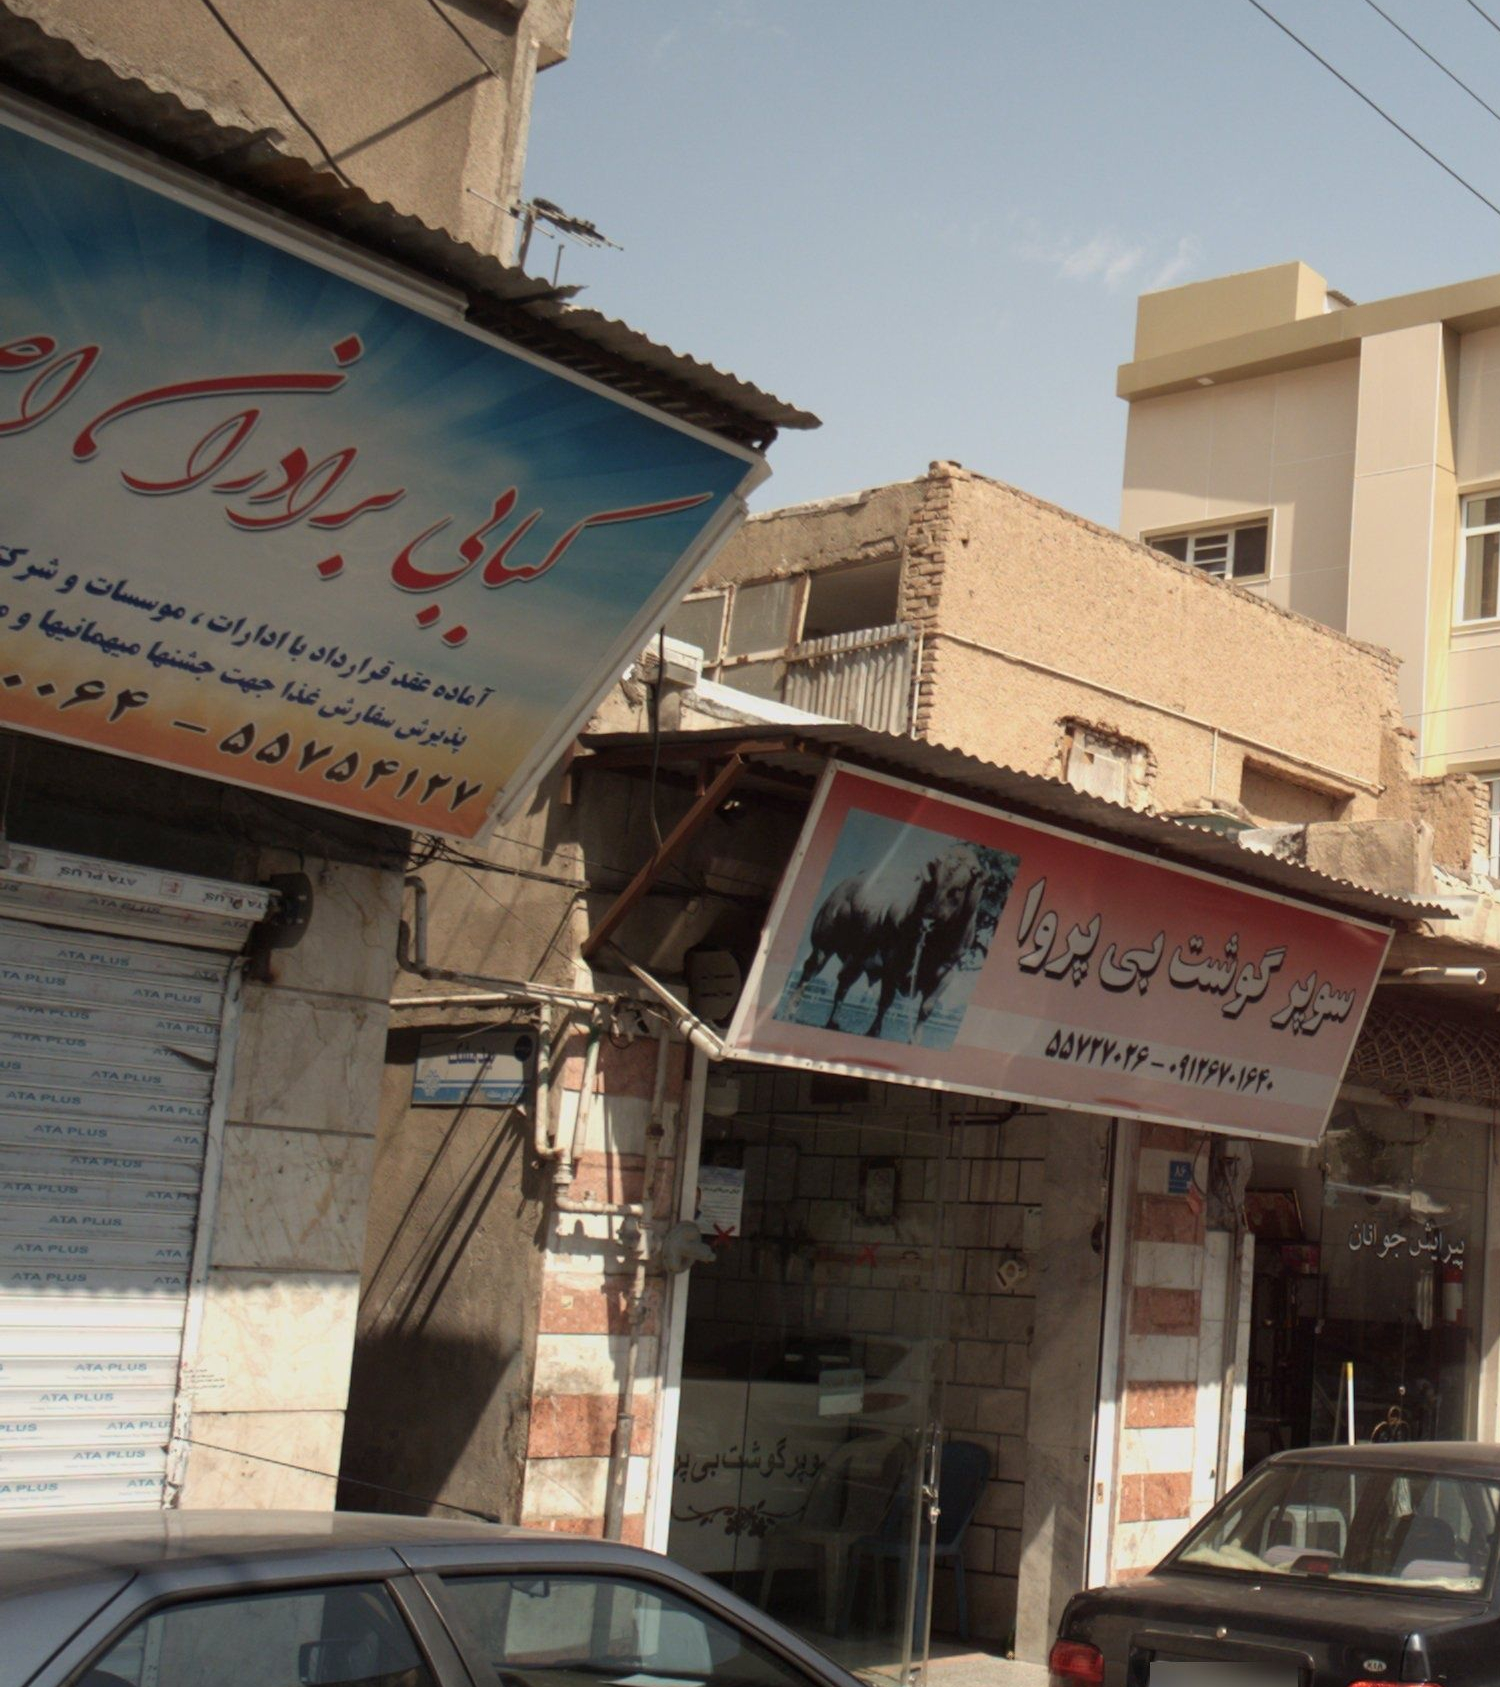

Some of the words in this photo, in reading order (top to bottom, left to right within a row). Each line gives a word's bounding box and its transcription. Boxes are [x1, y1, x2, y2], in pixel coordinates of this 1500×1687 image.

[0, 546, 60, 582] شرک
[390, 486, 713, 647] کبابی
[55, 574, 79, 594] و
[84, 578, 186, 622] موسسات
[8, 612, 32, 631] و
[38, 608, 142, 658] میهمانیها
[206, 614, 291, 647] ادارات
[288, 635, 308, 662] با
[146, 640, 216, 681] جشنها
[309, 646, 395, 684] قرارداد
[219, 668, 276, 699] جهت
[391, 671, 432, 693] عقد
[281, 680, 321, 706] غذا
[432, 686, 496, 708] آماده
[317, 697, 396, 730] سفارش
[394, 719, 468, 755] پذیرش
[218, 721, 484, 813] ۵۵۷۵۴۱۲۷
[1017, 876, 1102, 988] پروا
[57, 950, 86, 961] ATA
[90, 953, 131, 967] PLUS
[27, 973, 67, 986] PLUS
[1168, 932, 1288, 1018] گوشت
[133, 988, 161, 999] ATA
[163, 992, 203, 1004] PLUS
[1271, 970, 1357, 1037] سوپر
[16, 1004, 46, 1014] ATA
[50, 1008, 91, 1020] PLUS
[156, 1021, 183, 1032] ATA
[44, 1036, 88, 1047] PLUS
[91, 1071, 120, 1081] ATA
[123, 1073, 162, 1084] PLUS
[6, 1091, 36, 1101] ATA
[40, 1094, 82, 1105] PLUS
[147, 1104, 175, 1114] ATA
[178, 1107, 209, 1117] PLU
[34, 1125, 63, 1135] ATA
[67, 1127, 108, 1138] PLUS
[173, 1136, 200, 1146] ATA
[70, 1157, 99, 1166] ATA
[102, 1158, 143, 1168] PLUS
[3, 1182, 32, 1192] ATA
[38, 1184, 79, 1194] PLUS
[146, 1190, 172, 1199] ATA
[48, 1215, 78, 1225] ATA
[82, 1217, 123, 1227] PLUS
[14, 1244, 43, 1253] ATA
[48, 1245, 89, 1255] PLUS
[1348, 1223, 1407, 1259] جوانان
[1409, 1222, 1465, 1270] پیرایش
[155, 1250, 182, 1258] ATA
[11, 1272, 41, 1282] ATA
[46, 1273, 87, 1283] PLUS
[154, 1277, 181, 1285] ATA
[74, 1363, 104, 1372] ATA
[108, 1363, 147, 1372] PLUS
[40, 1393, 70, 1402] ATA
[74, 1393, 114, 1402] PLUS
[107, 1421, 135, 1430] ATA
[73, 1452, 103, 1461] ATA
[106, 1450, 146, 1459] PLUS
[721, 1437, 787, 1478] گوشت
[690, 1454, 719, 1483] بی
[16, 1482, 59, 1493] PLUS
[127, 1479, 155, 1488] ATA
